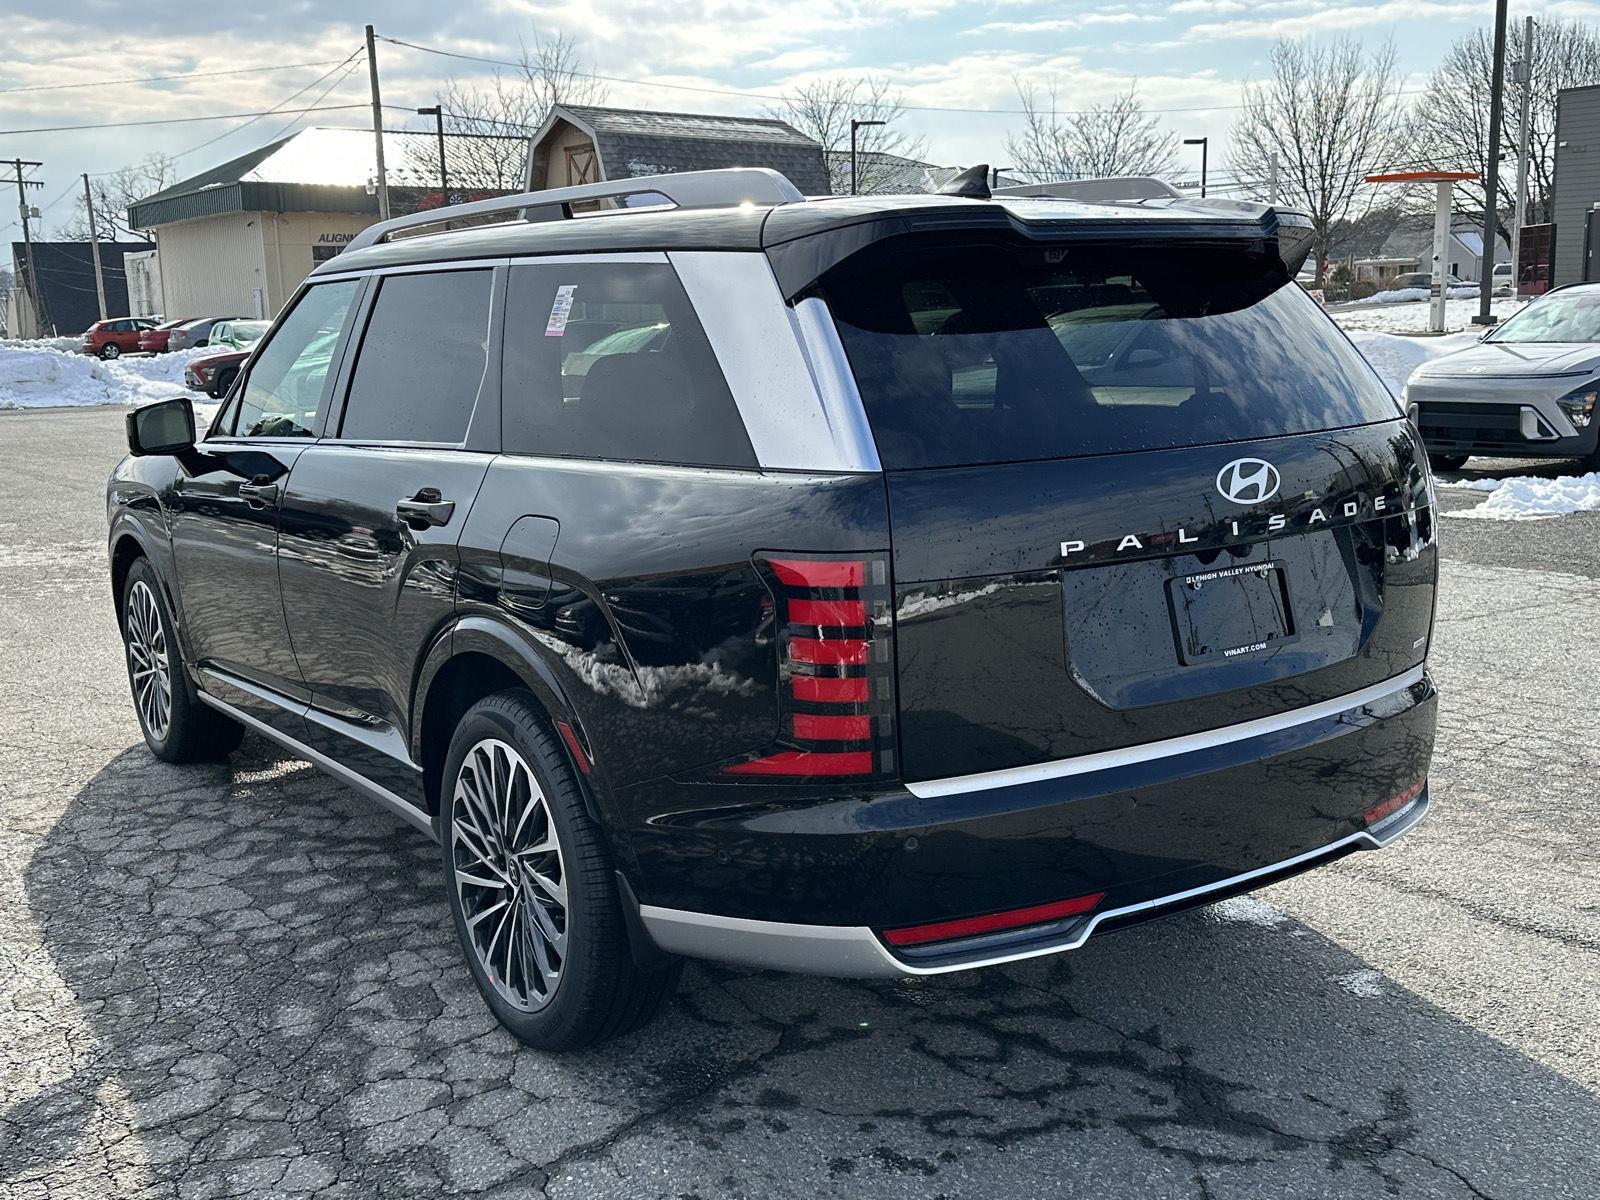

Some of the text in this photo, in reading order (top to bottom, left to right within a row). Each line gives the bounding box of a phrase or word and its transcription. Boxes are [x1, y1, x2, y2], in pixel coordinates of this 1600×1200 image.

[1060, 495, 1386, 557] PALISADE
[1191, 562, 1274, 584] LEHIGH VALLEY HYUNDAI
[1223, 642, 1267, 657] VINART.COM
